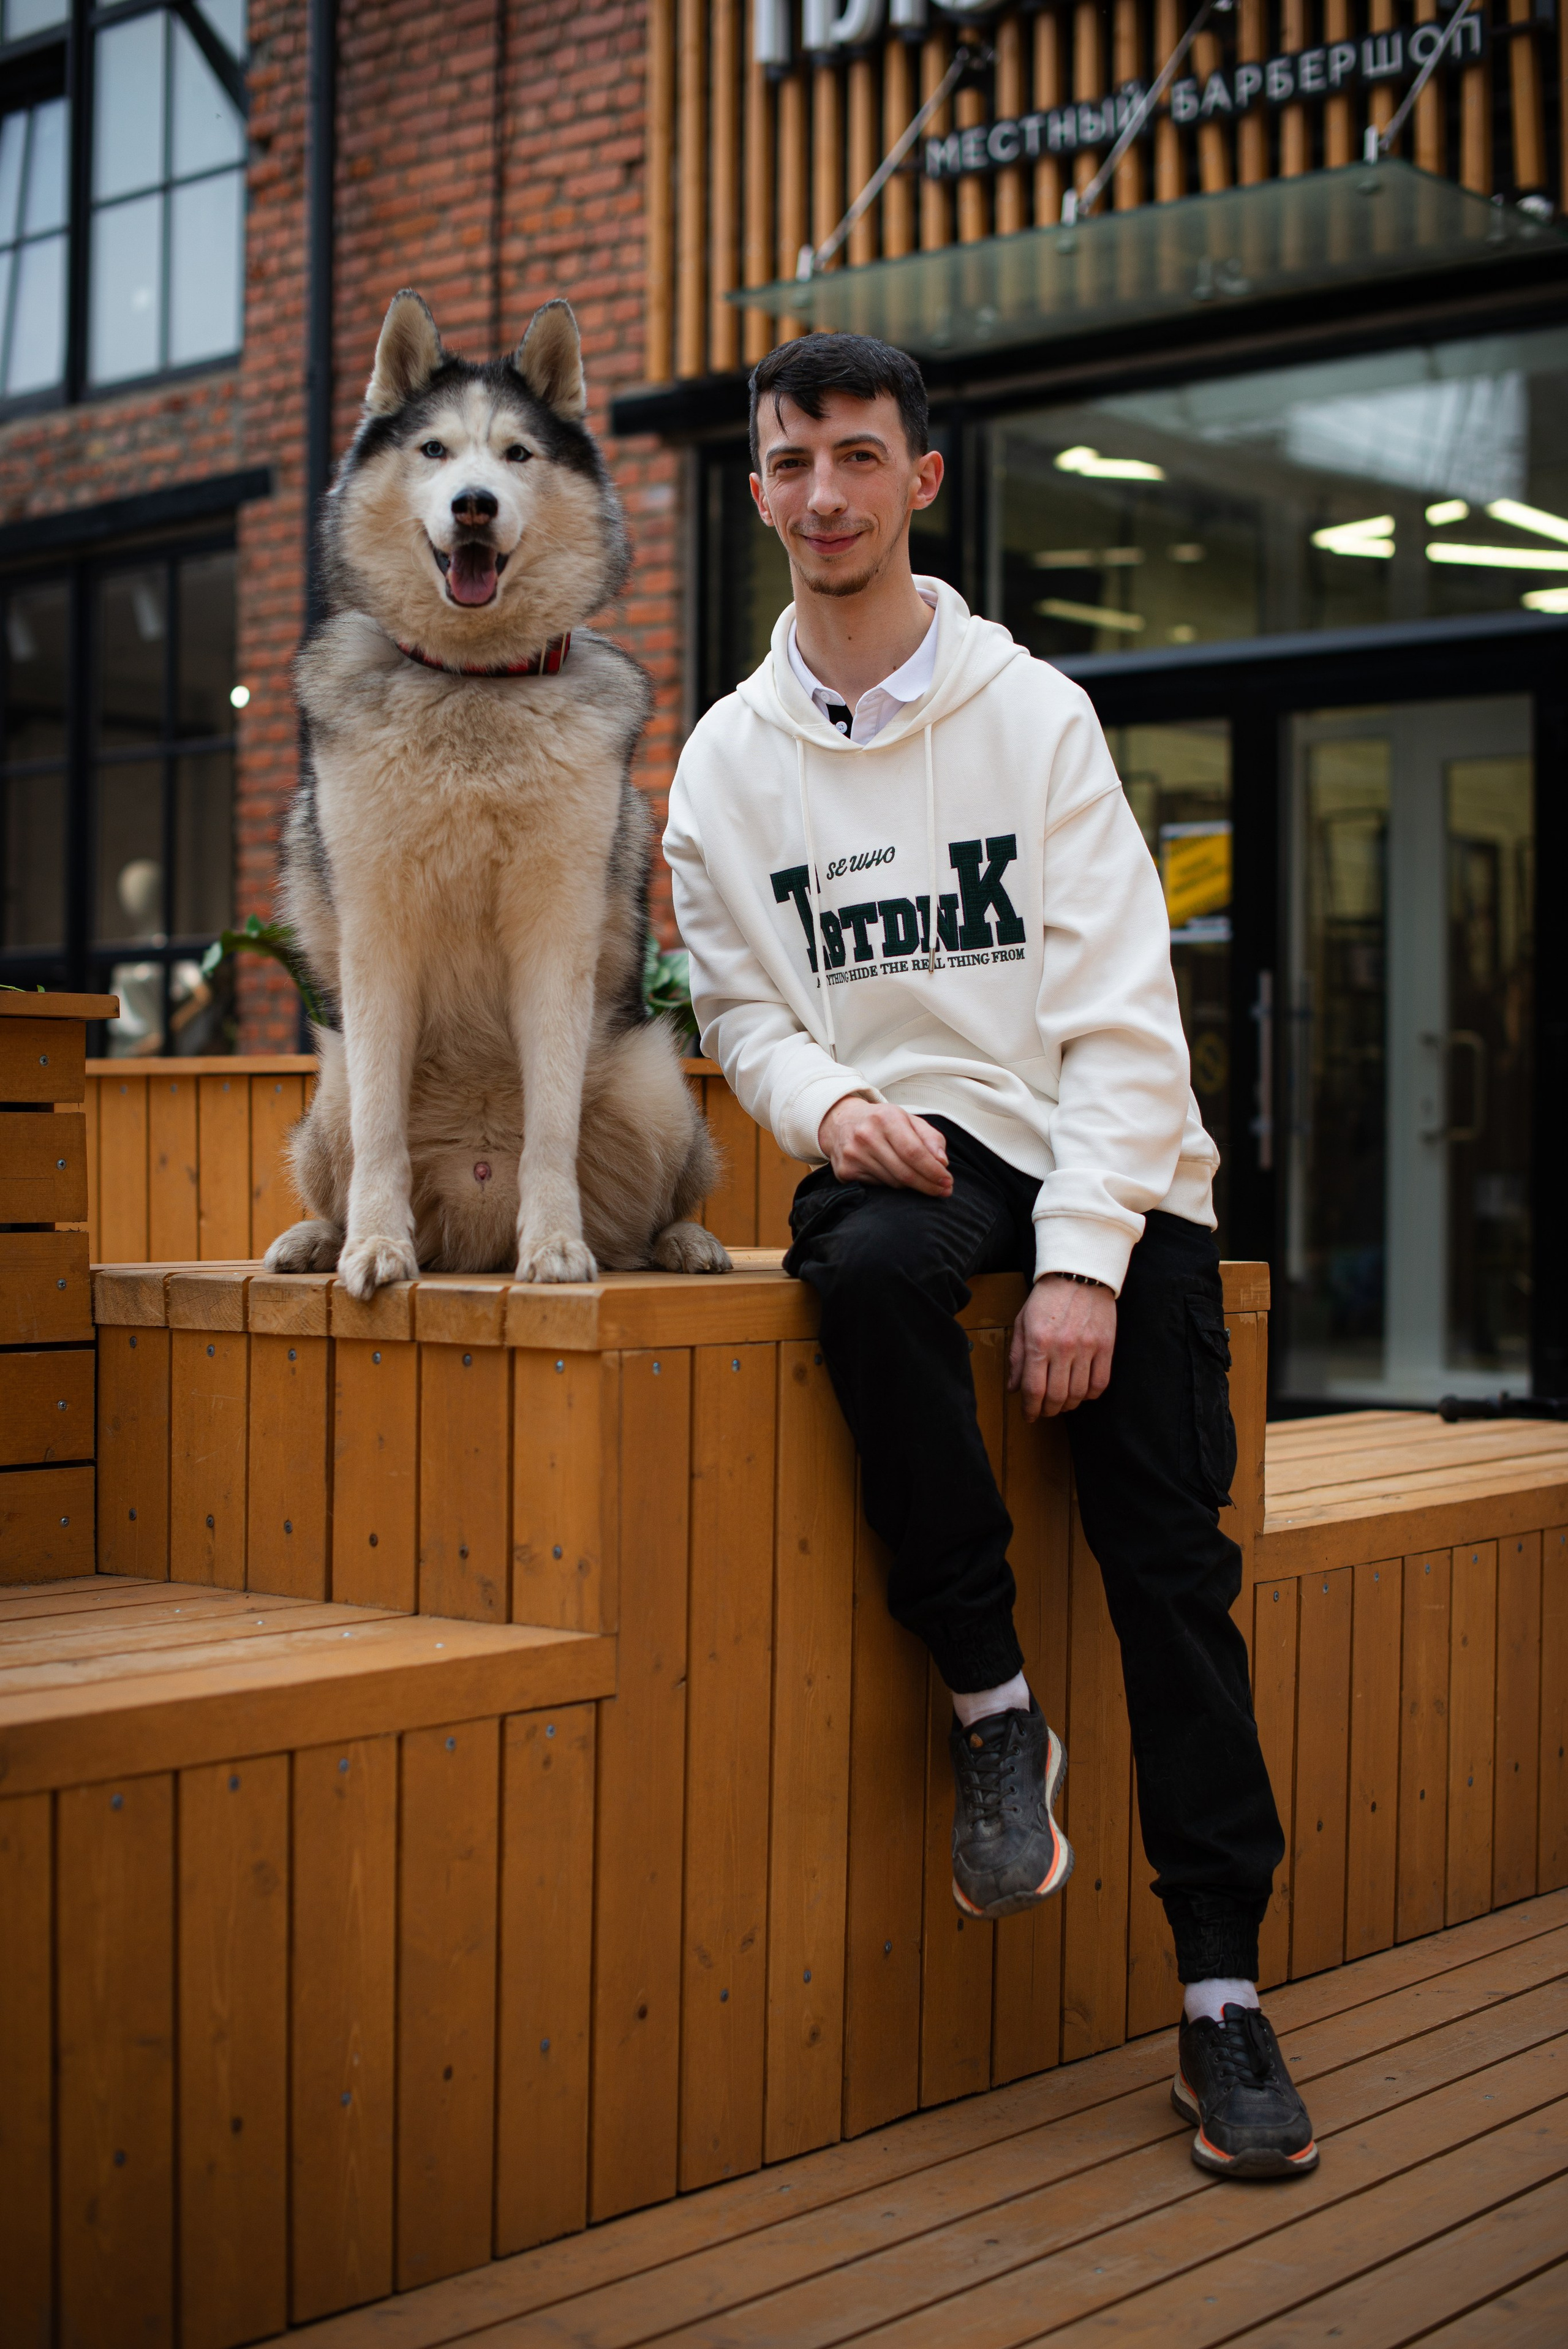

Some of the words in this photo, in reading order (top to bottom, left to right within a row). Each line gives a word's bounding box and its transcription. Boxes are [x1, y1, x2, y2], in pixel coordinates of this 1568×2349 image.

[925, 80, 1147, 178] МЕСТНЫЙ
[1170, 13, 1482, 123] БАРБЕРШОП
[816, 970, 849, 989] AYTHING
[848, 965, 878, 981] HIDE
[880, 959, 909, 975] THE
[948, 952, 990, 968] THING
[990, 948, 1025, 963] FROM
